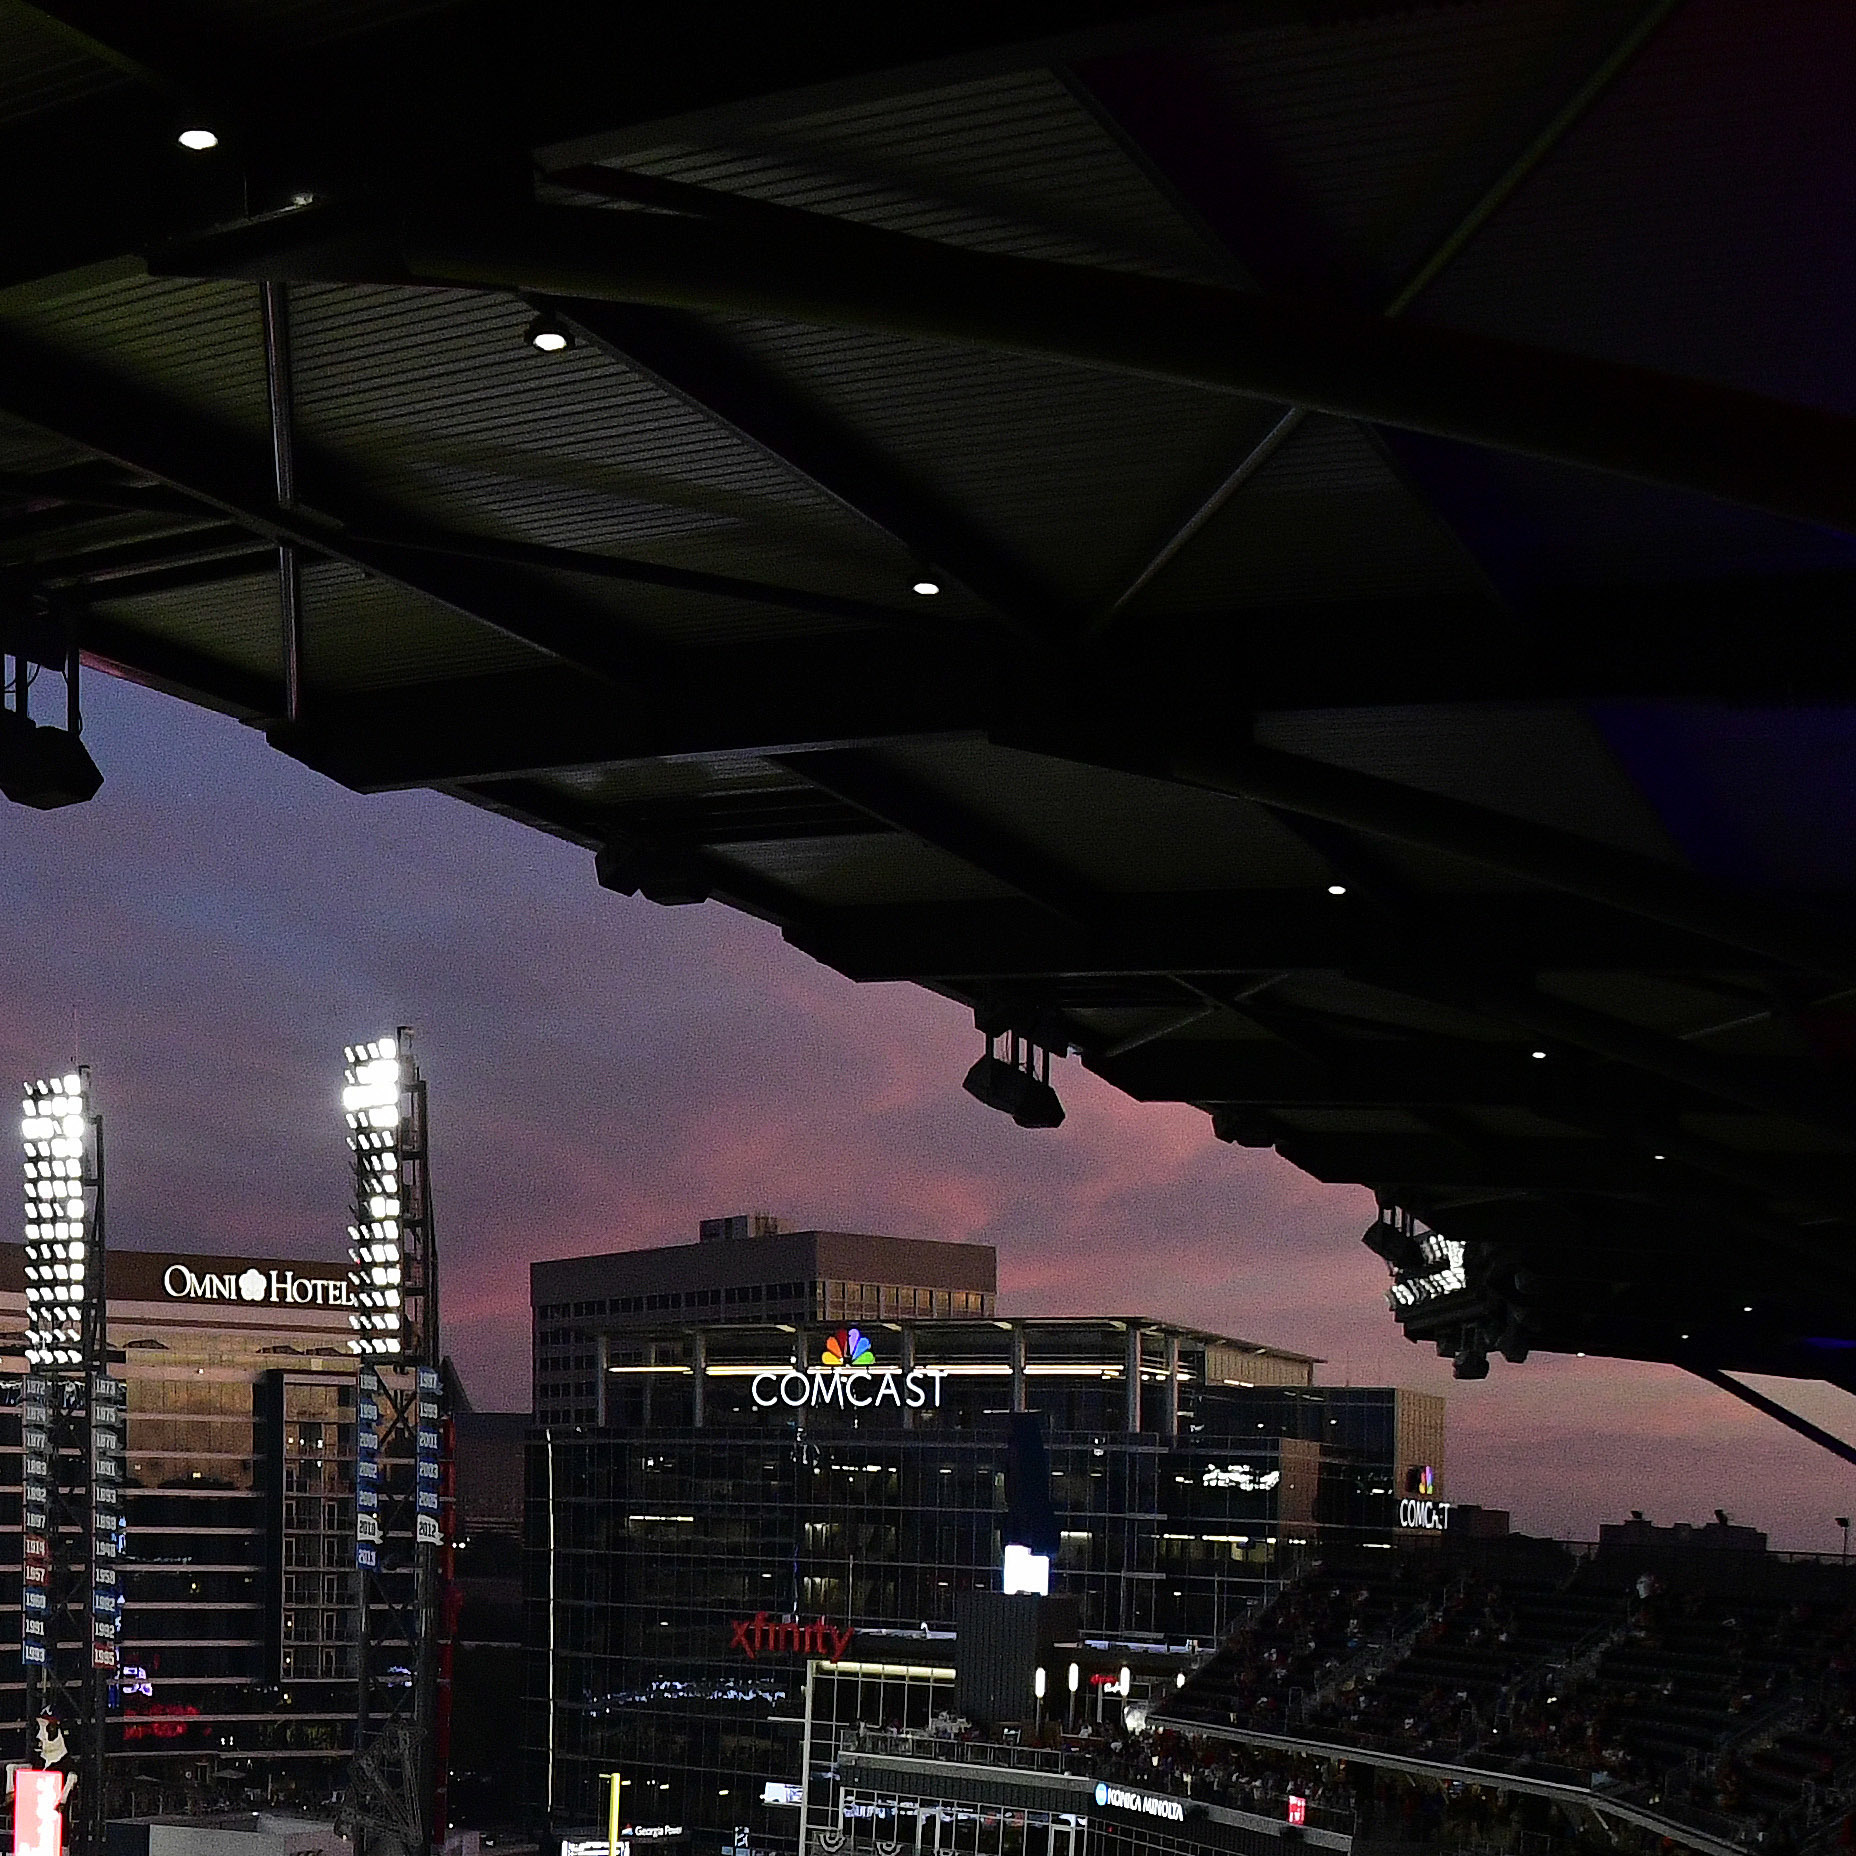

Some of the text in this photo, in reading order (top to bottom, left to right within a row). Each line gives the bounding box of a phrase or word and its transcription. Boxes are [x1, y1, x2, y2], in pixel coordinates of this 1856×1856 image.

[164, 1264, 355, 1306] OMNI HOTEL
[752, 1372, 949, 1407] COMCAST
[26, 1620, 46, 1636] 1991
[731, 1611, 854, 1664] xfinity
[1107, 1787, 1184, 1821] KONICA MINOLTA
